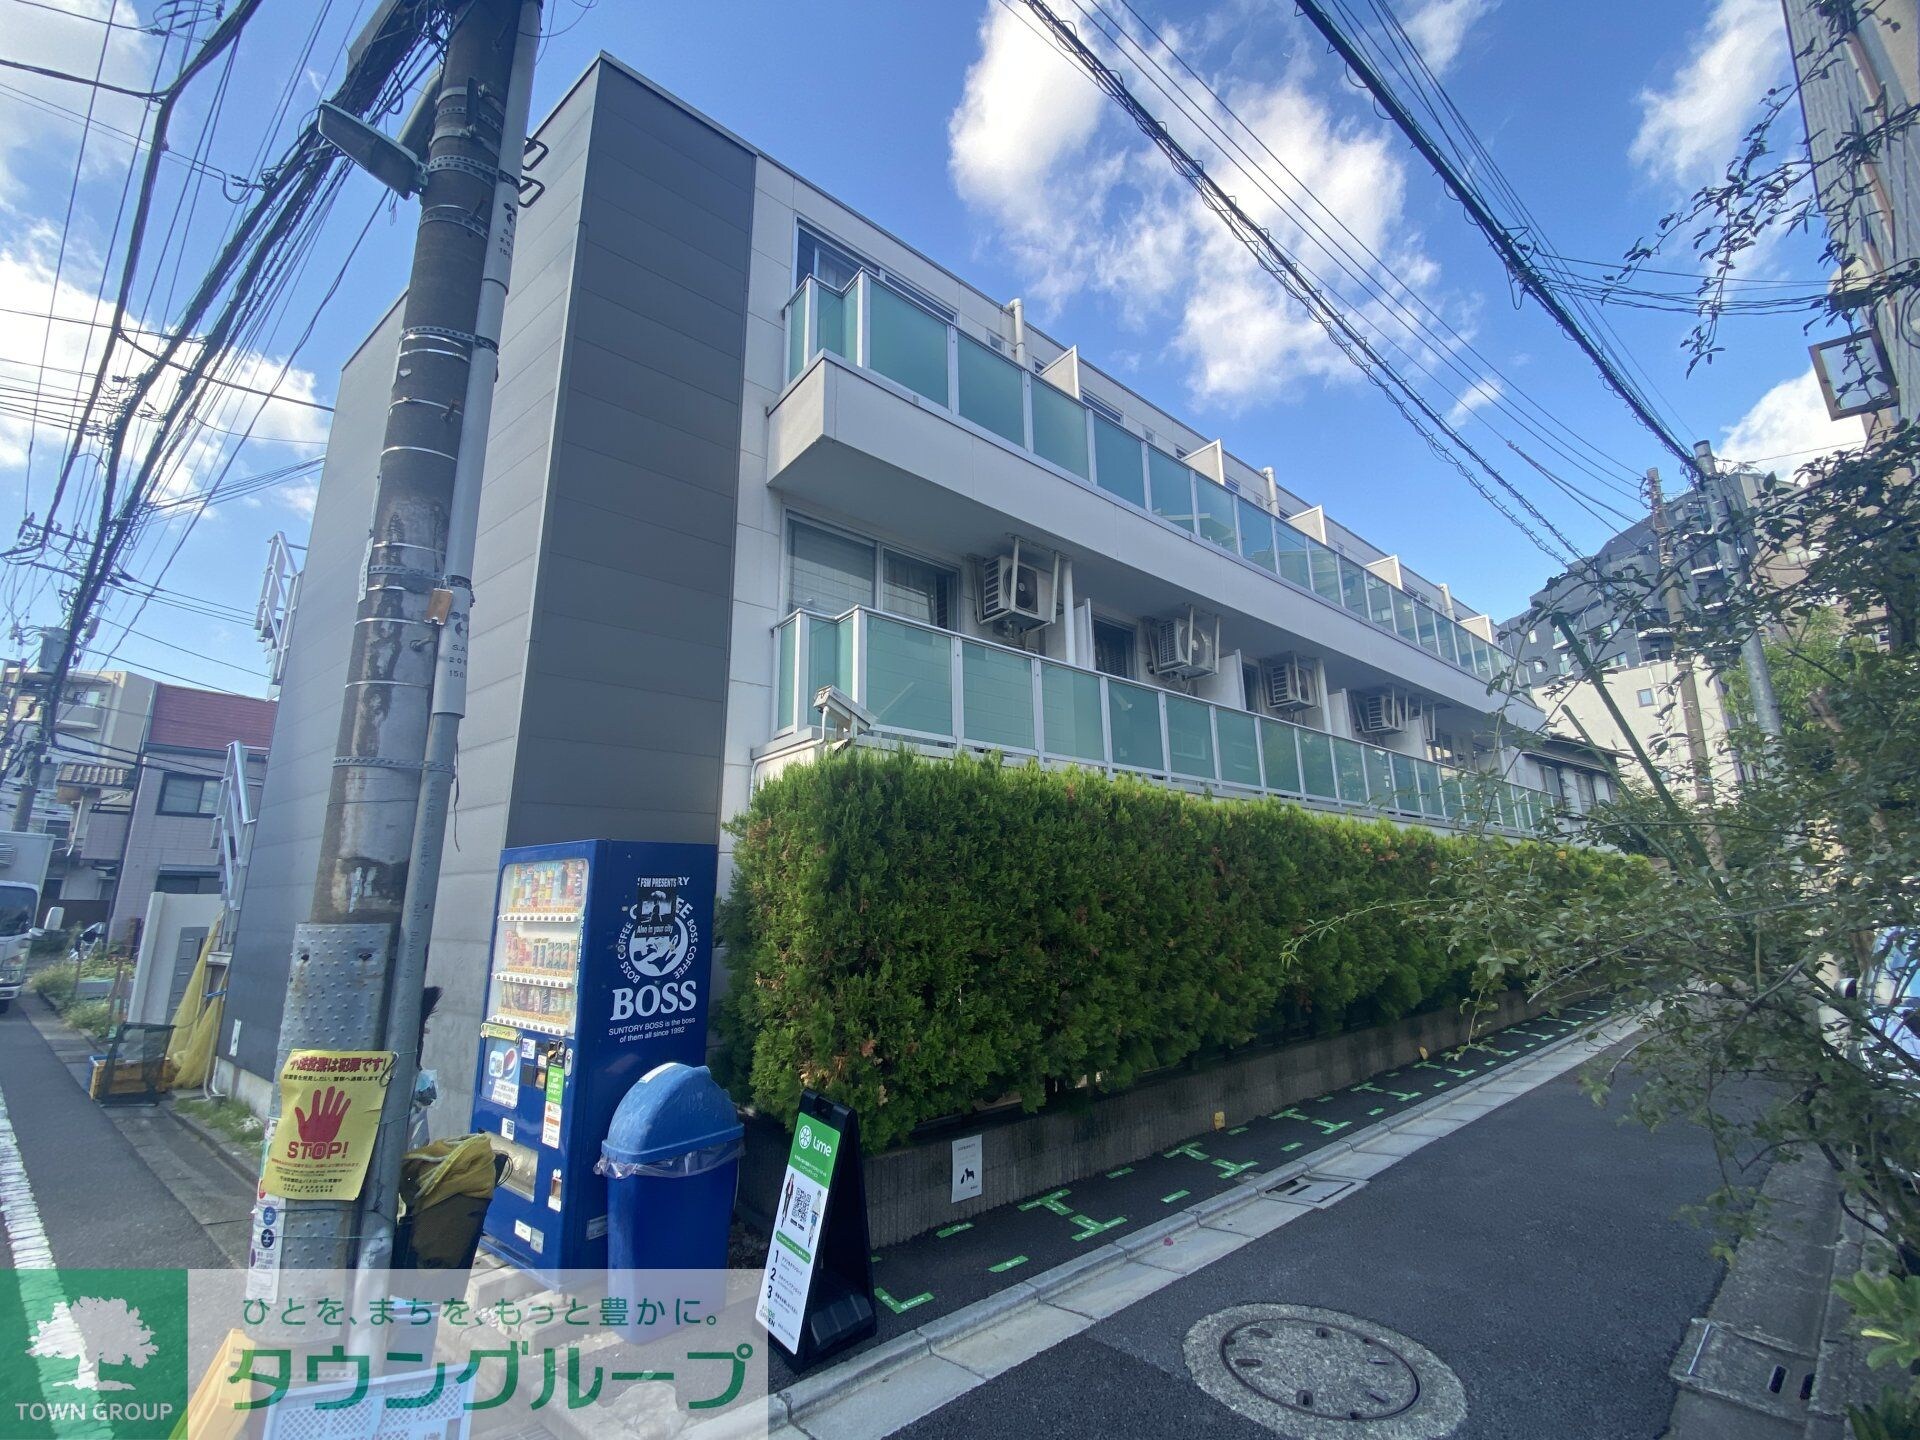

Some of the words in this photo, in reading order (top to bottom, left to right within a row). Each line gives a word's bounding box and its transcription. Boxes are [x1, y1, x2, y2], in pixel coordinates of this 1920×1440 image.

[652, 878, 677, 888] PRESENTS
[617, 921, 634, 960] COFFEE
[687, 919, 698, 943] BOSS
[620, 961, 640, 984] BOSS
[673, 946, 697, 980] COFFEE
[610, 980, 697, 1021] BOSS
[608, 1024, 644, 1036] SUNTORY
[644, 1021, 664, 1030] BOSS
[671, 1018, 681, 1026] the
[681, 1017, 696, 1025] boss
[627, 1033, 643, 1042] them
[653, 1030, 669, 1038] since
[670, 1026, 685, 1035] 1992
[287, 1141, 349, 1160] STOP!
[774, 1249, 779, 1263] 1
[770, 1267, 777, 1281] 2
[767, 1285, 773, 1299] 3
